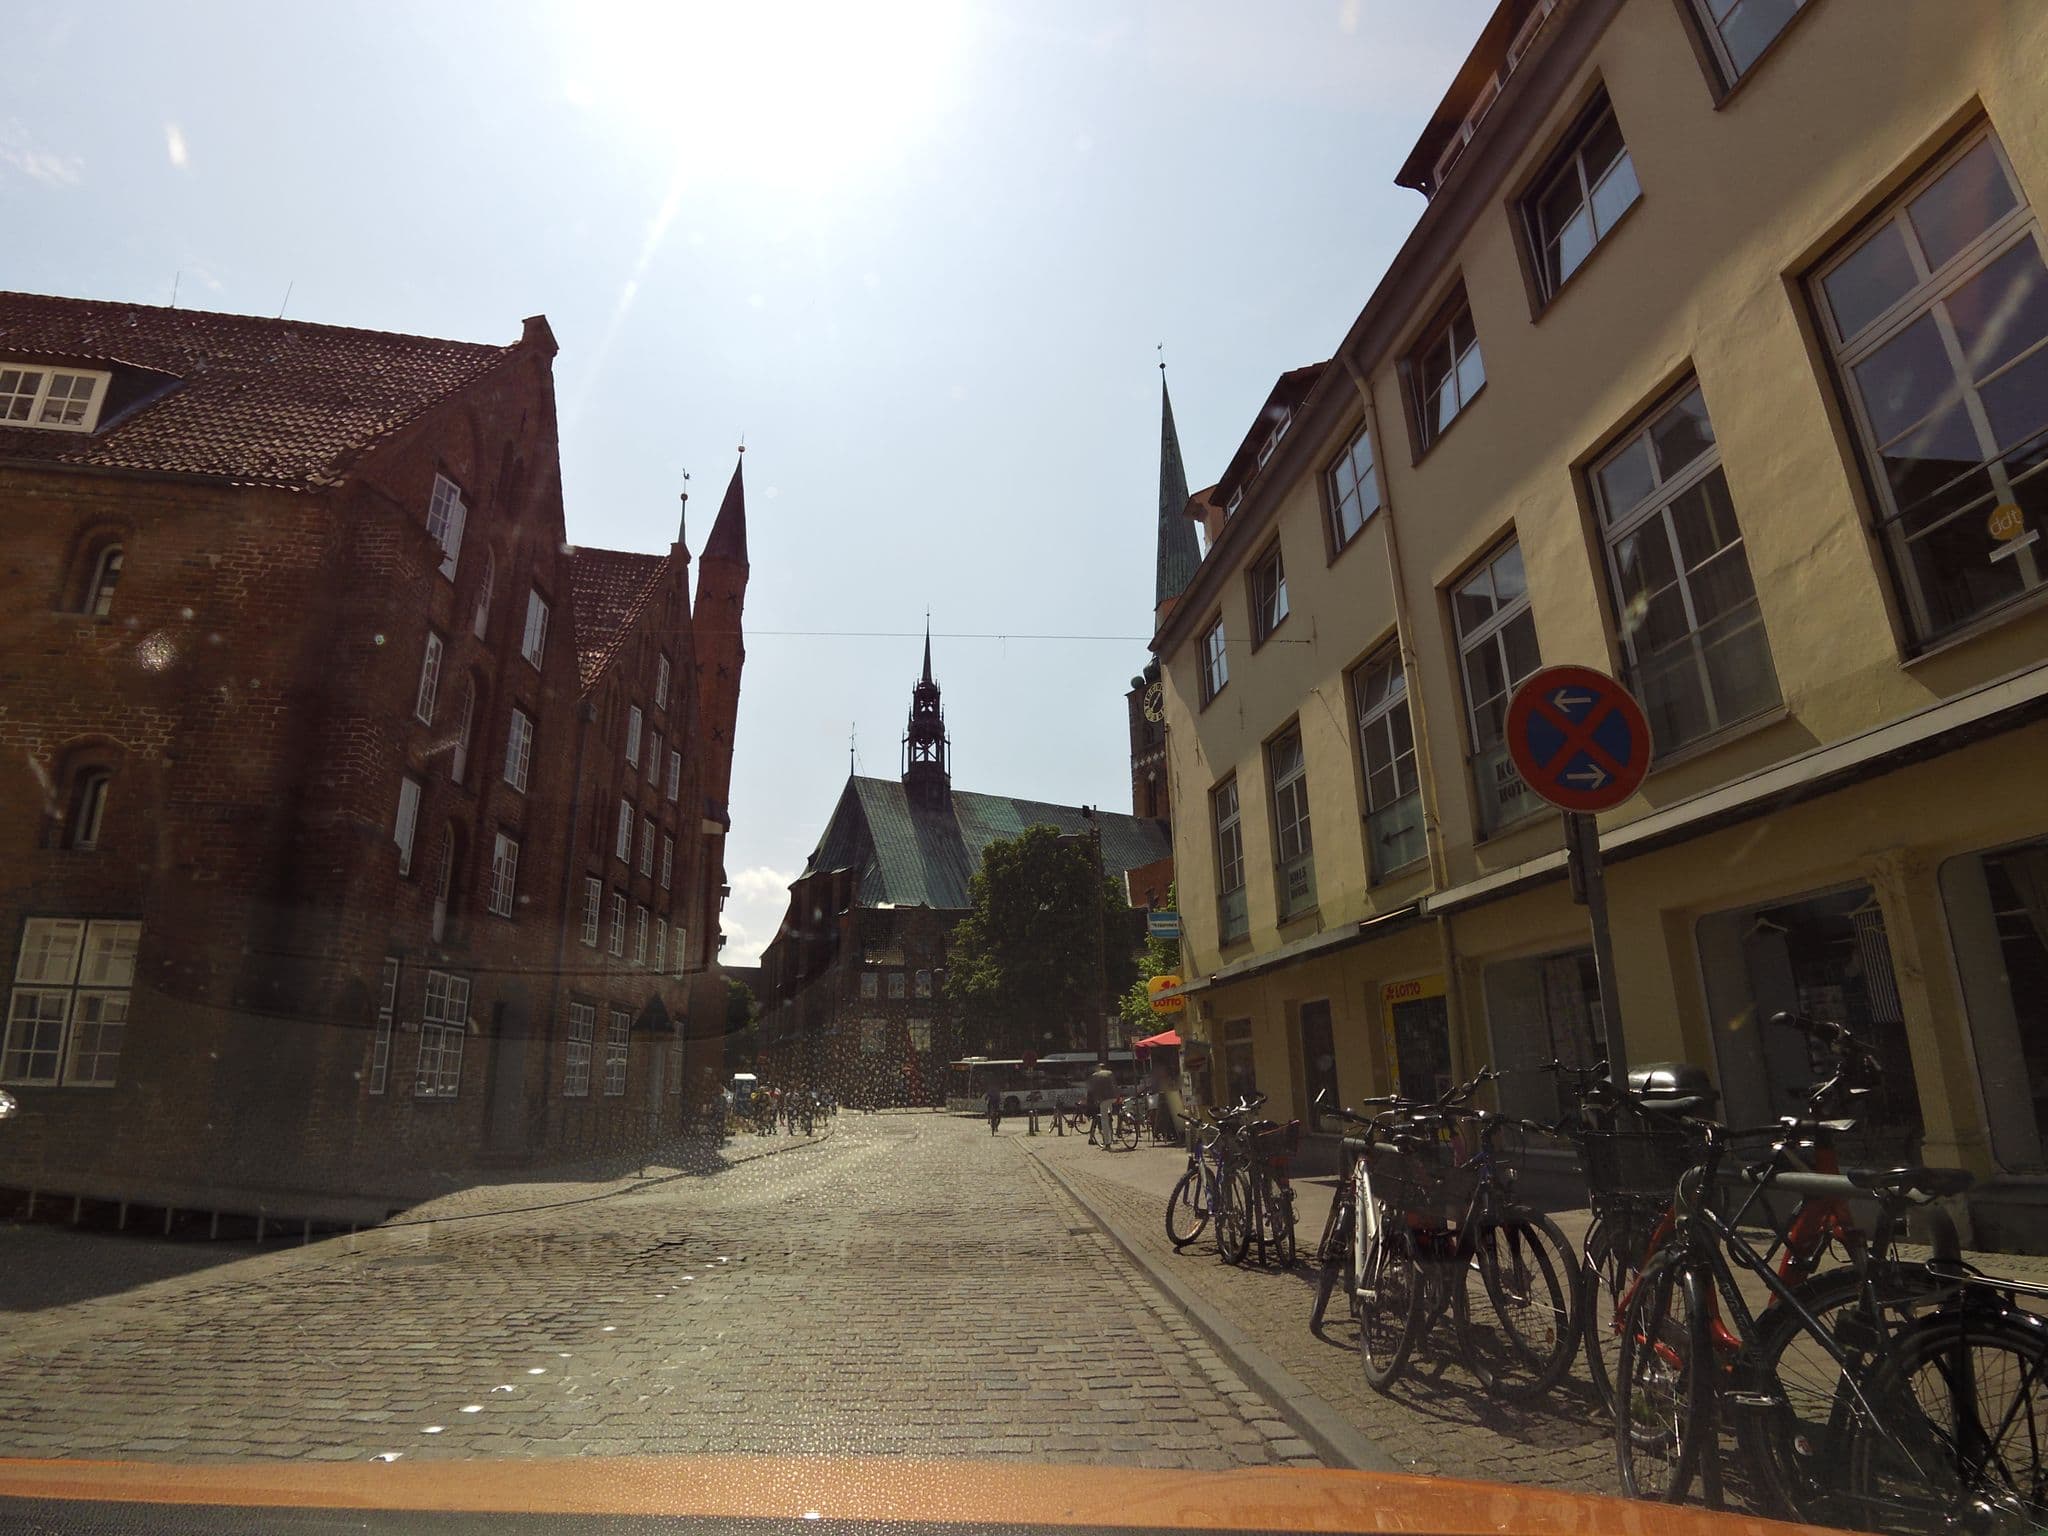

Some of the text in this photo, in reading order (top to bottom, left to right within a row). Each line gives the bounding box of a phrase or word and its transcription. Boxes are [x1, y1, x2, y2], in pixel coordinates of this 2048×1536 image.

[1991, 509, 2021, 535] ddt
[1394, 981, 1420, 998] LOTTO
[1153, 997, 1182, 1008] LOTTO
